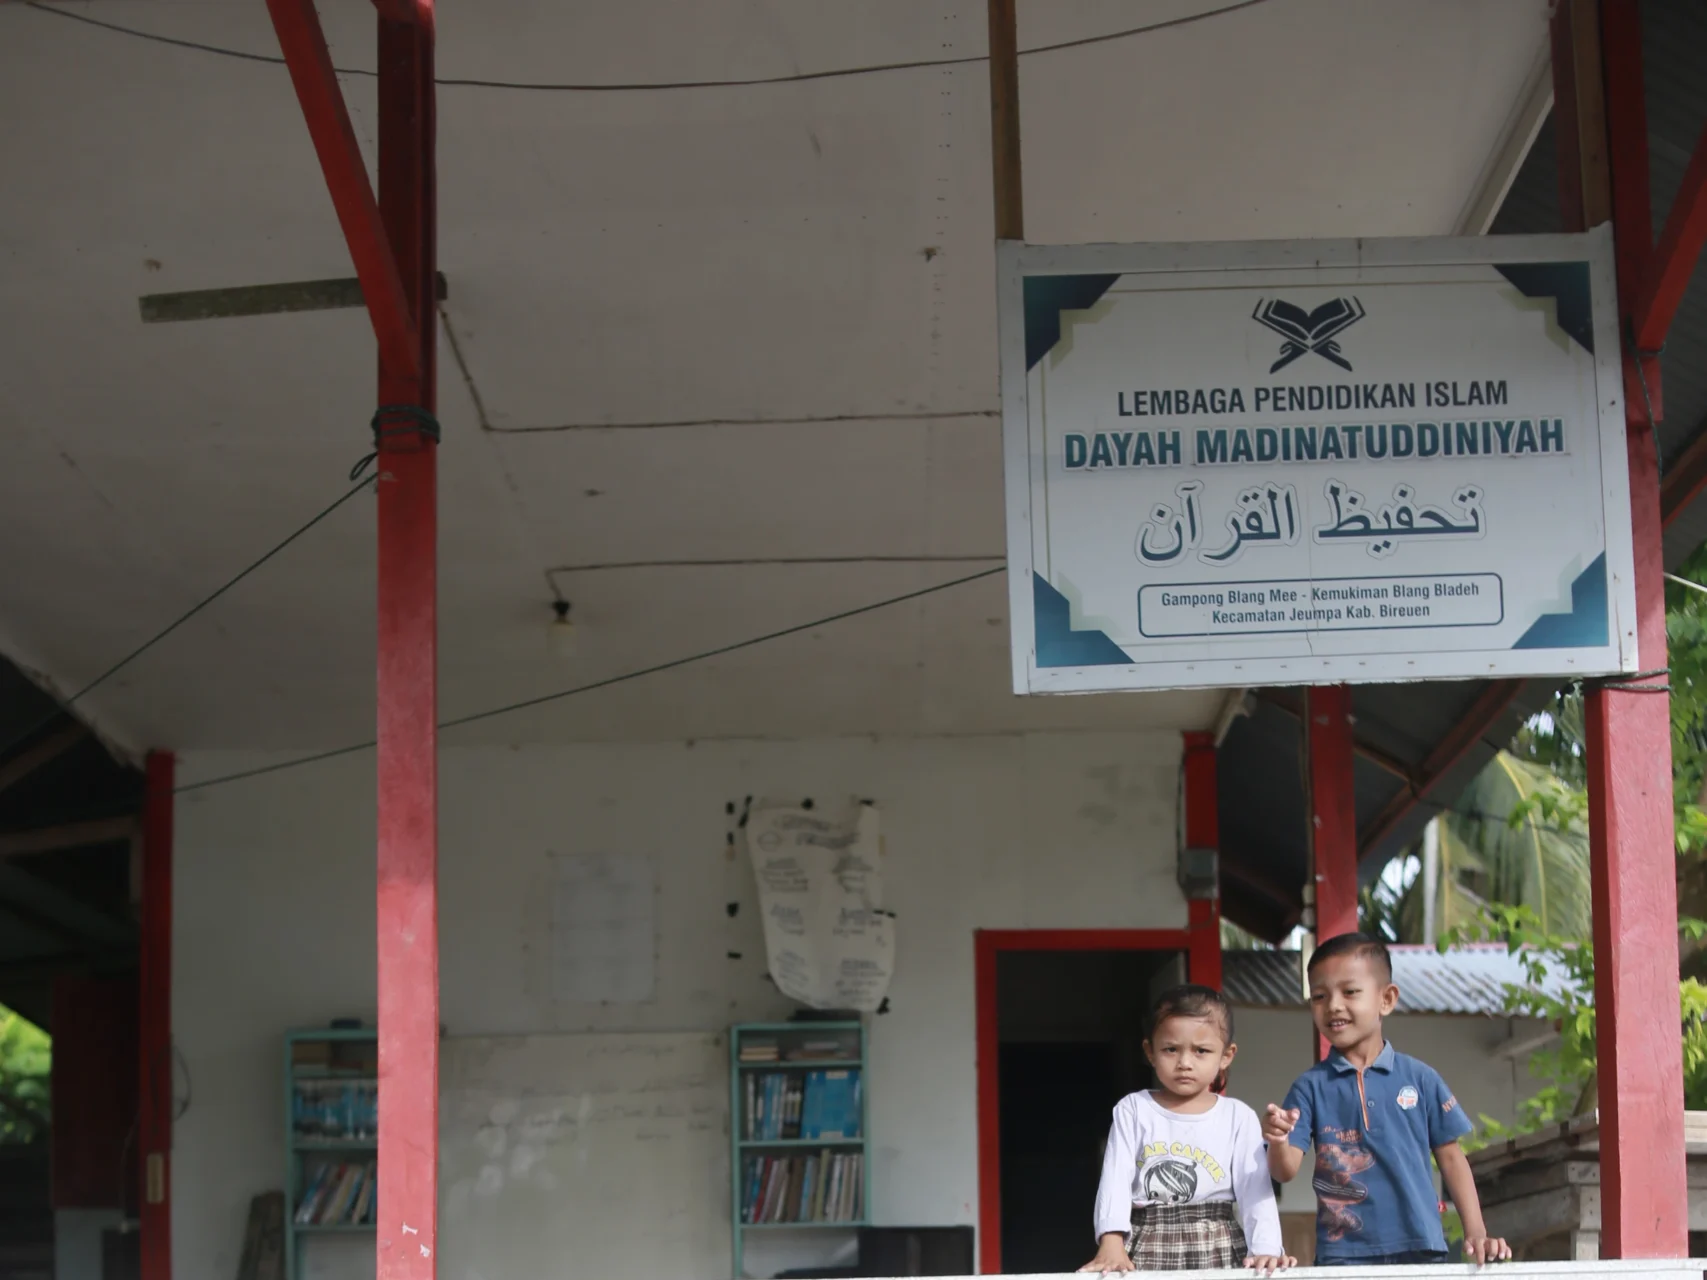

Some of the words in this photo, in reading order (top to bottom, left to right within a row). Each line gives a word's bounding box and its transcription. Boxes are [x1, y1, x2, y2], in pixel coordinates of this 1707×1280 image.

[1118, 388, 1245, 416] LEMBAGA
[1255, 382, 1415, 412] PENDIDIKAN
[1425, 380, 1507, 407] ISLAM
[1065, 431, 1181, 468] DAYAH
[1196, 419, 1564, 463] MADINATUDDINIYAH
[1318, 485, 1480, 553] تحفيظ
[1162, 592, 1223, 607] Gampong
[1228, 590, 1265, 605] Blang
[1269, 589, 1297, 602] Mee
[1312, 587, 1388, 601] Kemukiman
[1392, 585, 1430, 599] Blang
[1434, 582, 1479, 597] Bladeh
[1212, 609, 1285, 623] Kecamatan
[1289, 607, 1342, 622] Jeumpa
[1346, 605, 1375, 619] Kab.
[1380, 604, 1430, 618] Bireuen
